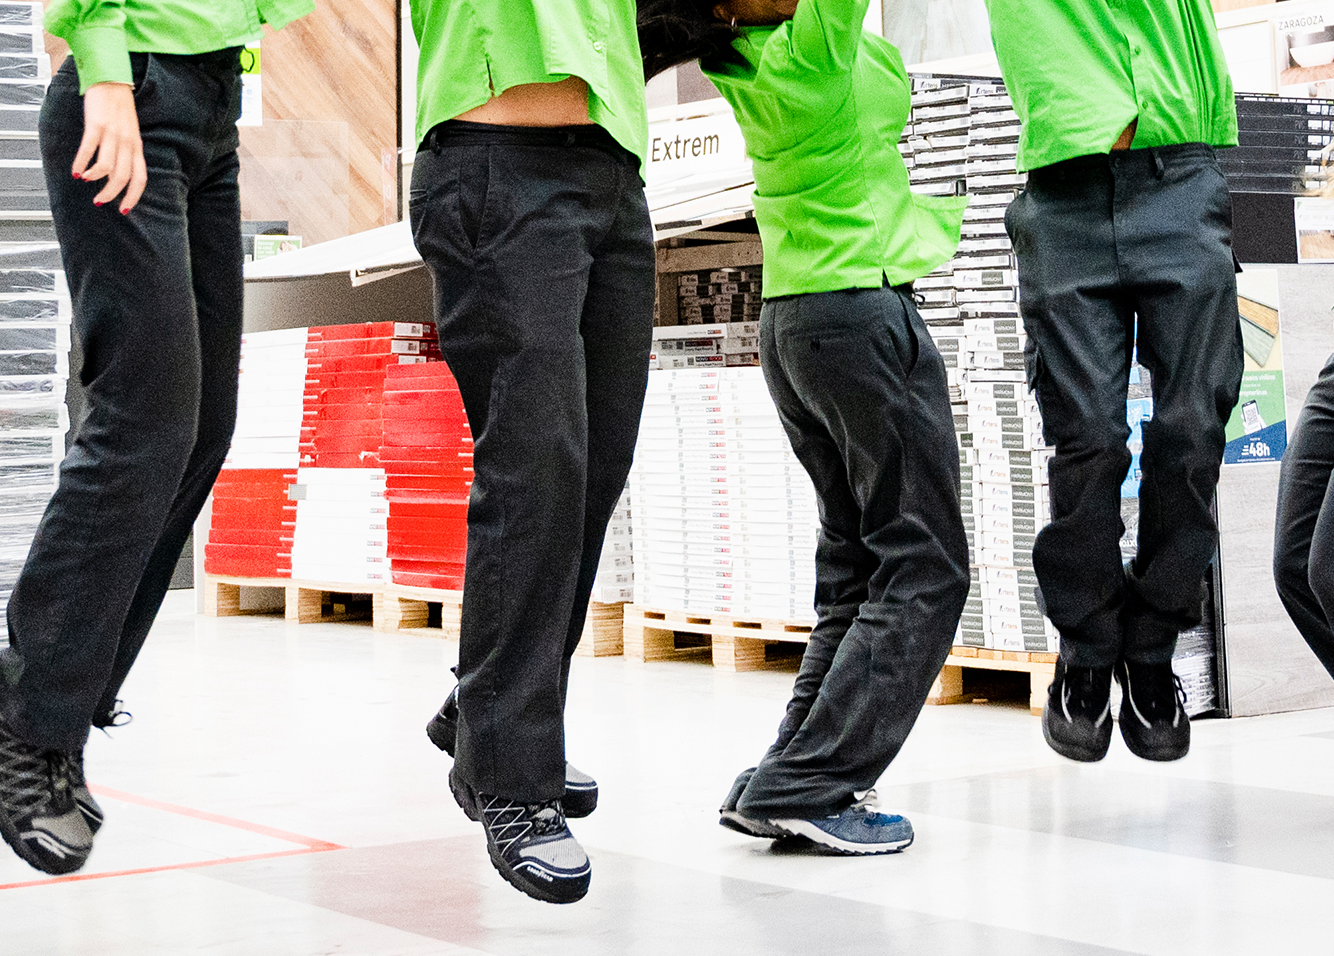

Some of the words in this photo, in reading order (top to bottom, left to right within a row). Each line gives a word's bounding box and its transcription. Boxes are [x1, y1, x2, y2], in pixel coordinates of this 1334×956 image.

[1278, 15, 1324, 31] ZARAGOZA
[651, 134, 720, 163] Extrem
[1249, 442, 1271, 457] 48h
